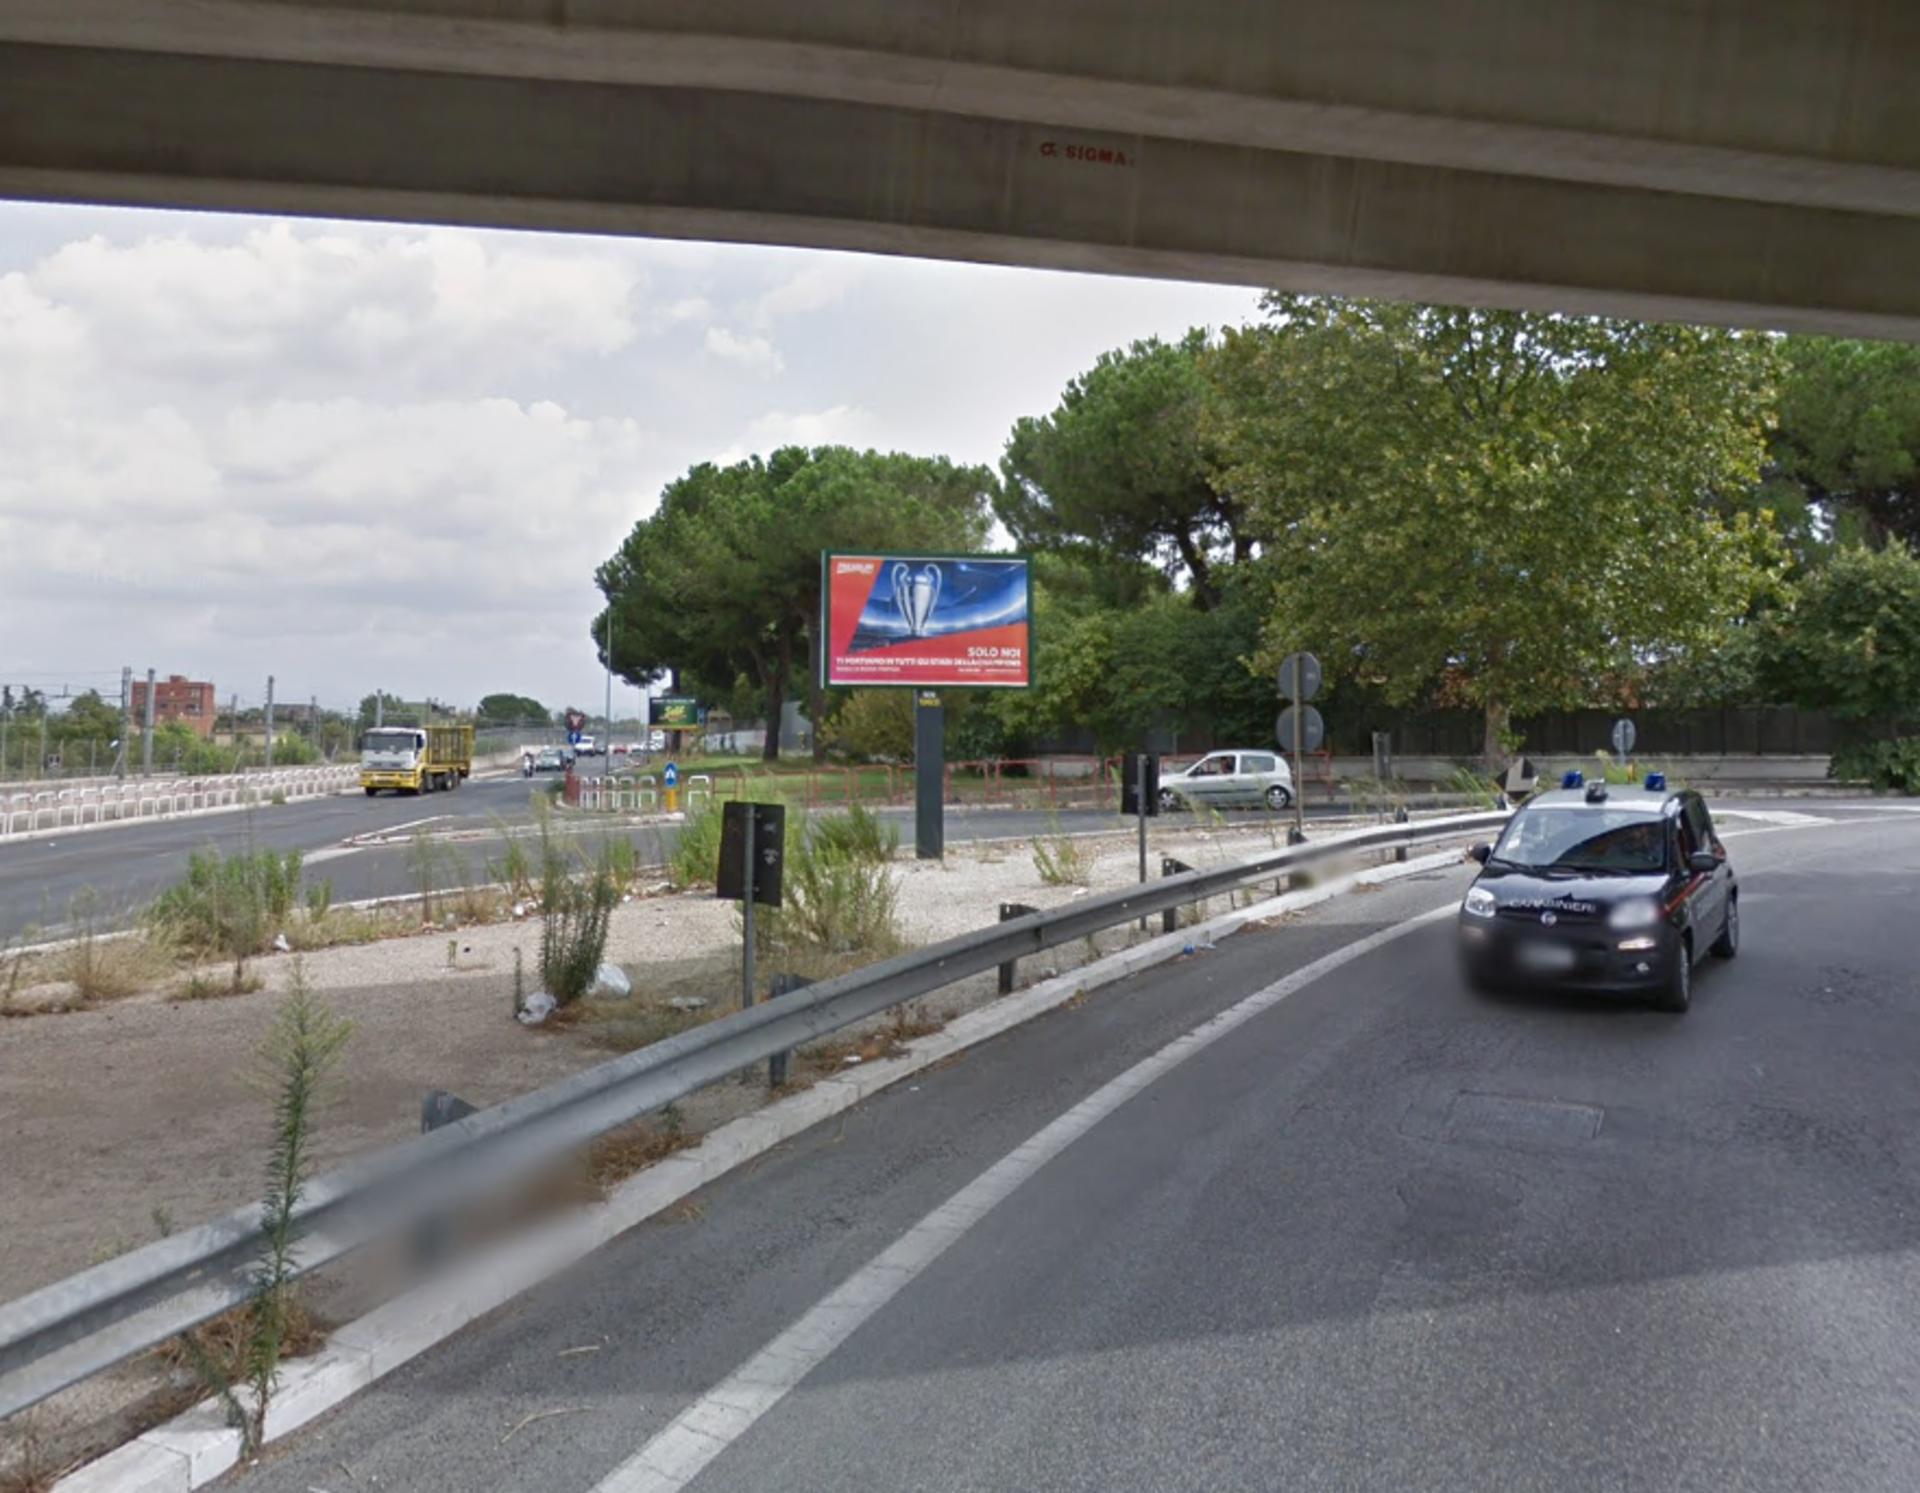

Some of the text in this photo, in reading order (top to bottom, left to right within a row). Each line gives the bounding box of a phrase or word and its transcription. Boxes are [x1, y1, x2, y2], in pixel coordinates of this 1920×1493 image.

[967, 646, 1021, 658] SOLO NOI
[895, 658, 916, 666] TUTTI
